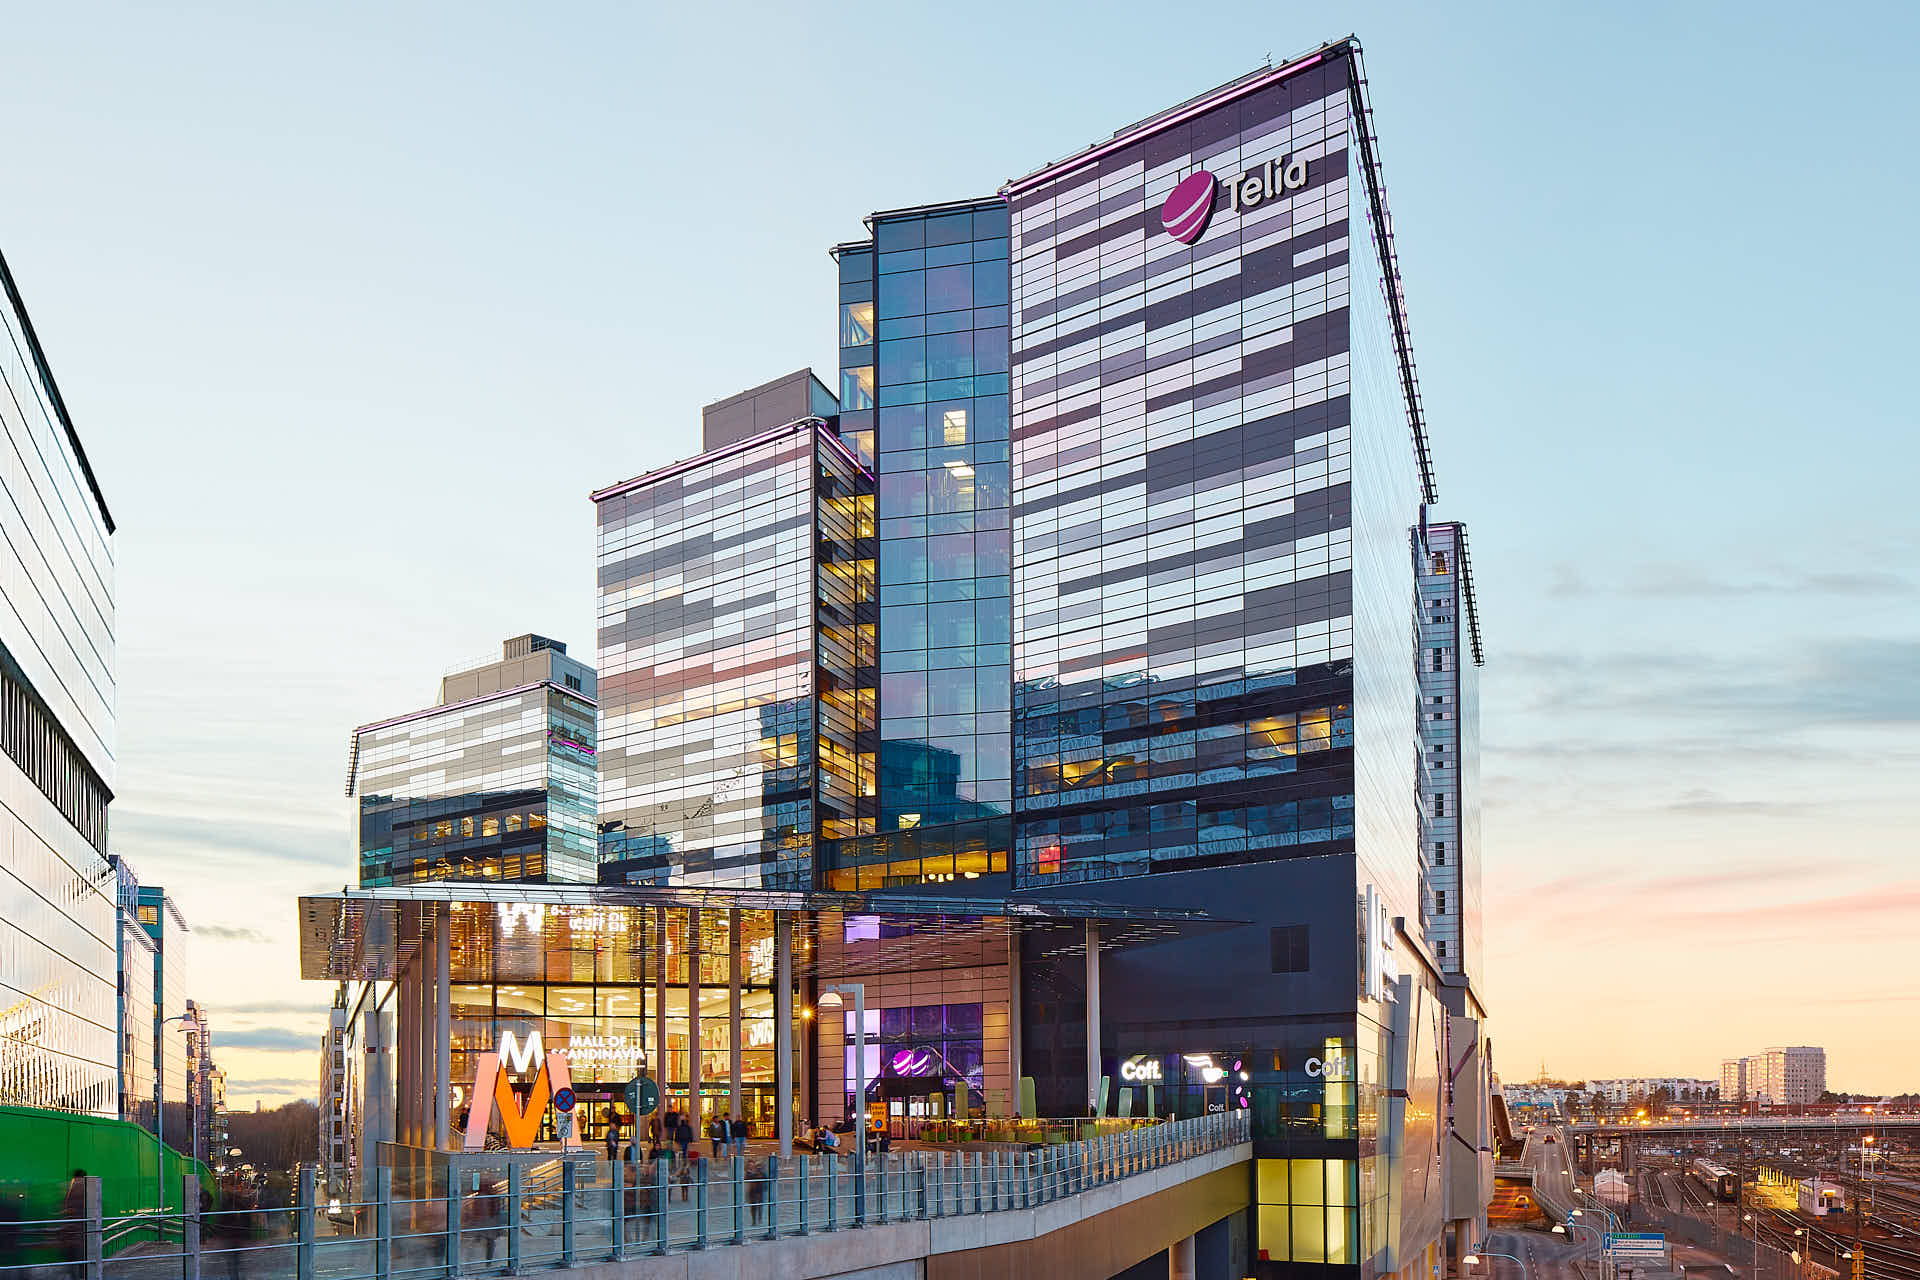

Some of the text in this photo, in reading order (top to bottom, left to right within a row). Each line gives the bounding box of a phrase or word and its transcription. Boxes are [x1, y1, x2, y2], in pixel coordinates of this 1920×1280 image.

[1222, 155, 1307, 212] Telia
[570, 1036, 626, 1047] MALL OF
